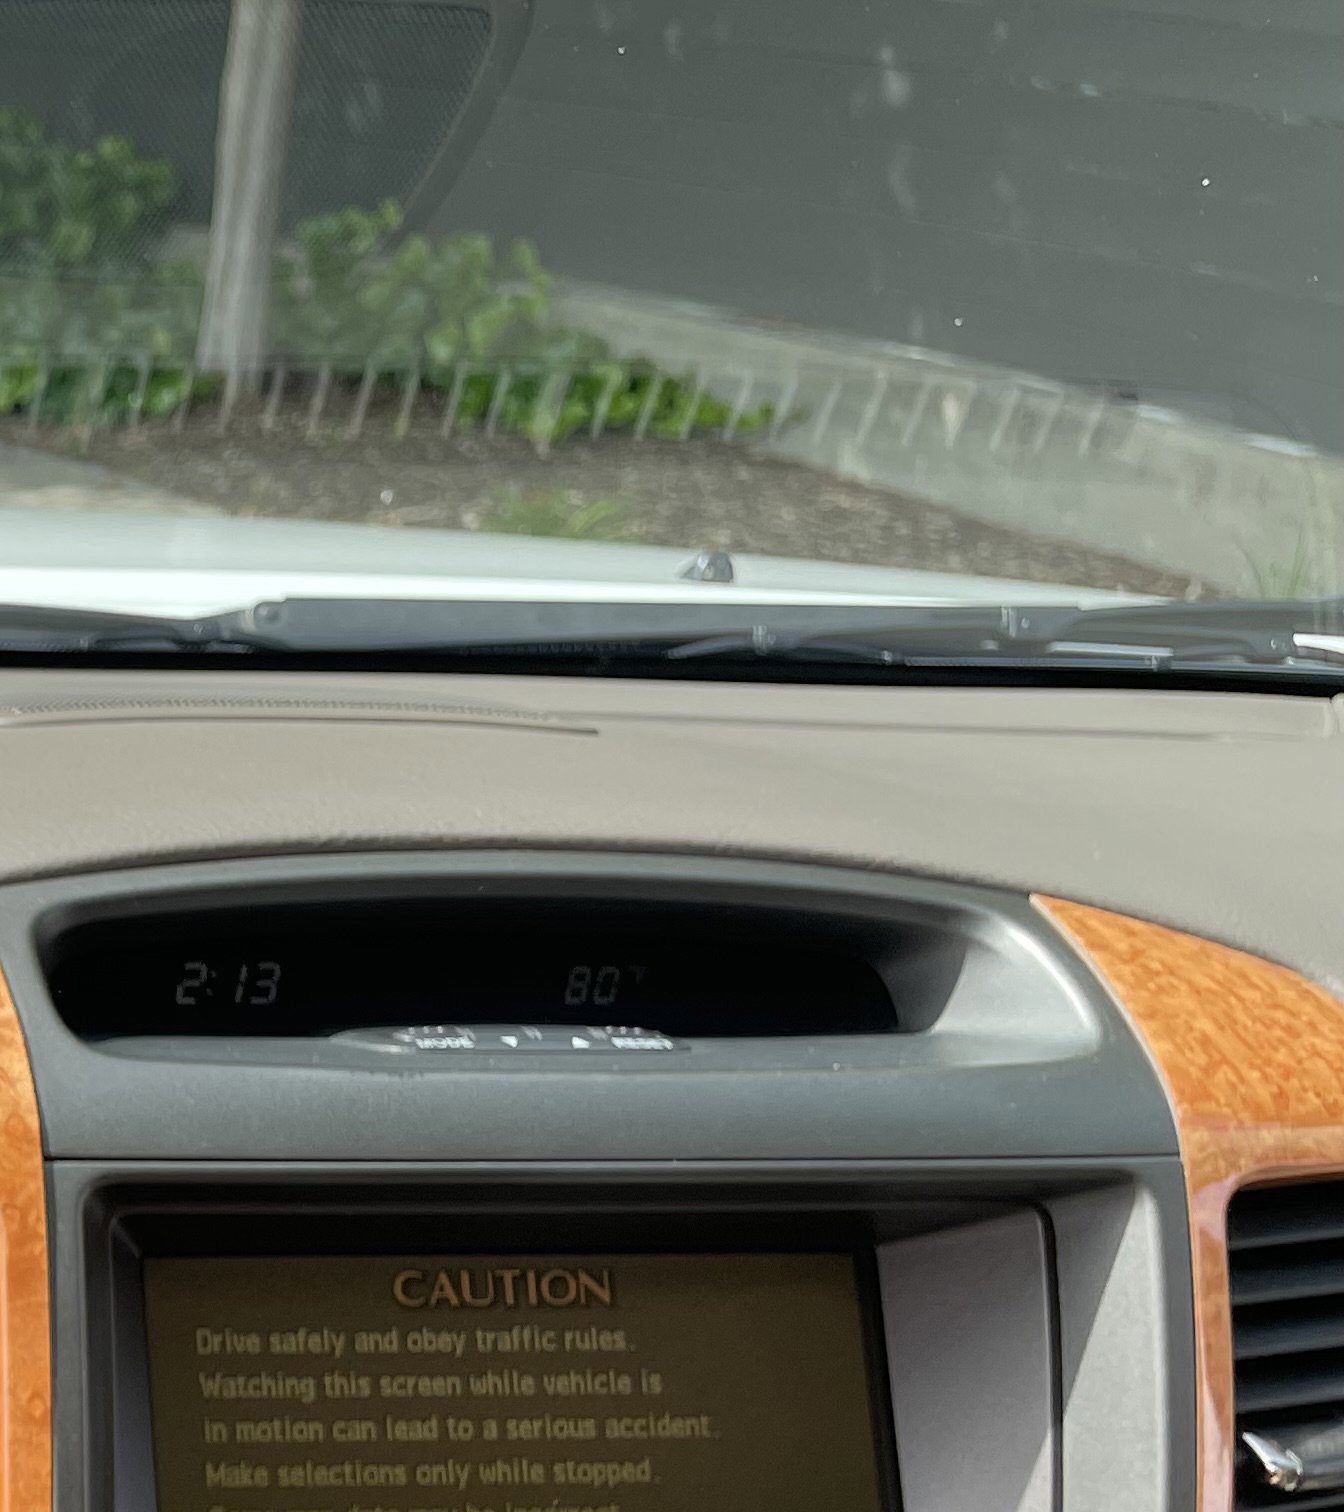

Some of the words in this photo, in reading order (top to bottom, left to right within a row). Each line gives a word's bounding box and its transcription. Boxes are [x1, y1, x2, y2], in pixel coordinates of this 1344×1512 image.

[176, 960, 281, 1005] 2:13
[392, 1268, 613, 1308] CAUTION
[196, 1327, 261, 1355] Drive
[269, 1326, 346, 1359] safely
[354, 1326, 399, 1354] and
[407, 1326, 467, 1358] obey
[475, 1324, 559, 1353] traffic
[564, 1325, 637, 1353] rules.
[199, 1372, 316, 1403] Watching
[324, 1371, 371, 1398] this
[379, 1373, 462, 1398] screen
[470, 1370, 536, 1397] while
[543, 1369, 633, 1396] vehicle
[641, 1368, 663, 1395] is
[203, 1416, 228, 1443] in
[235, 1416, 324, 1443] motion
[332, 1419, 378, 1442] can
[385, 1414, 439, 1442] lead
[446, 1416, 474, 1442] to
[481, 1419, 499, 1441] a
[507, 1413, 596, 1441] serious
[205, 1461, 269, 1488] Make
[276, 1460, 409, 1489] selections
[415, 1458, 471, 1491] only
[479, 1457, 545, 1487] while
